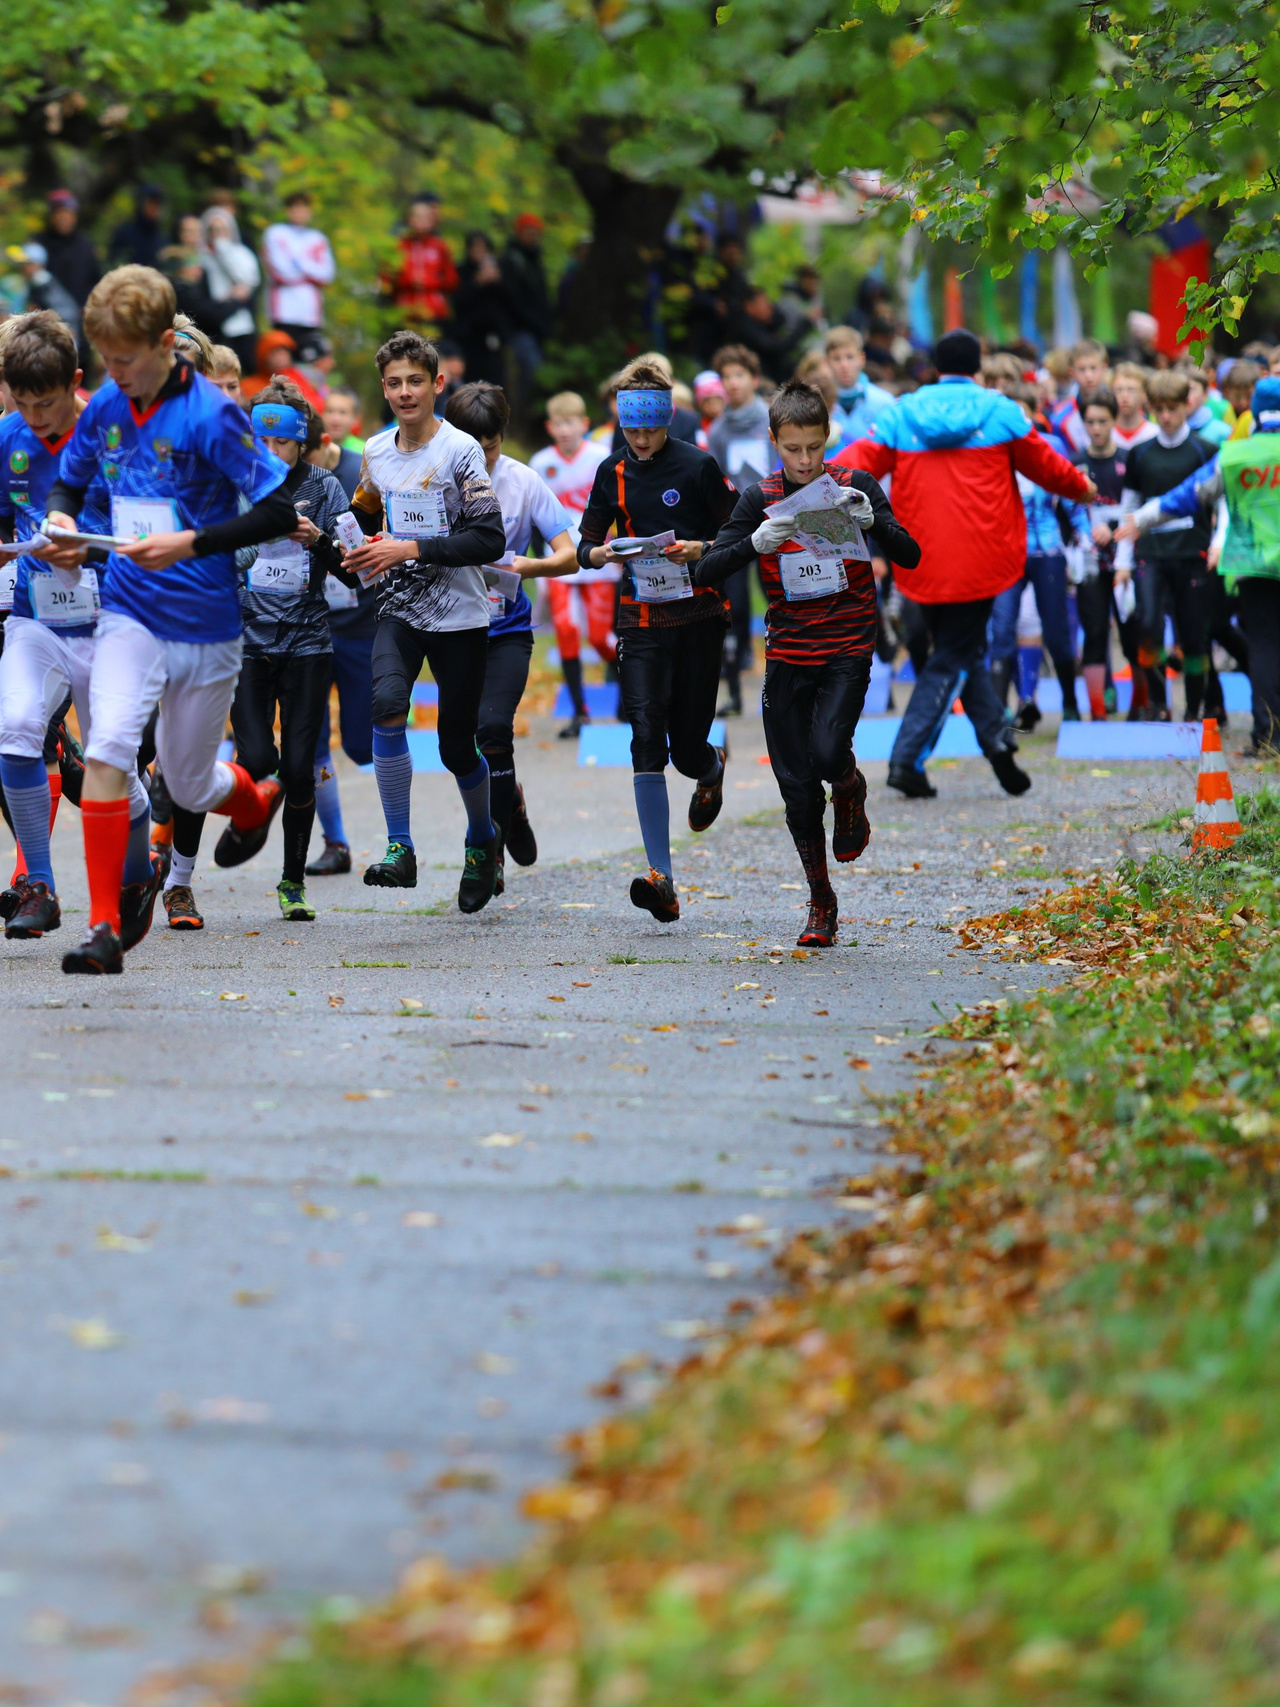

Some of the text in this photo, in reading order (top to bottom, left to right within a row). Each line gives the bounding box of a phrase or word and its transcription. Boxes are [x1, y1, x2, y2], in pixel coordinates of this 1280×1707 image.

[403, 511, 424, 522] 206
[266, 566, 288, 578] 207
[798, 564, 822, 577] 203
[646, 575, 666, 587] 204
[51, 591, 76, 604] 202
